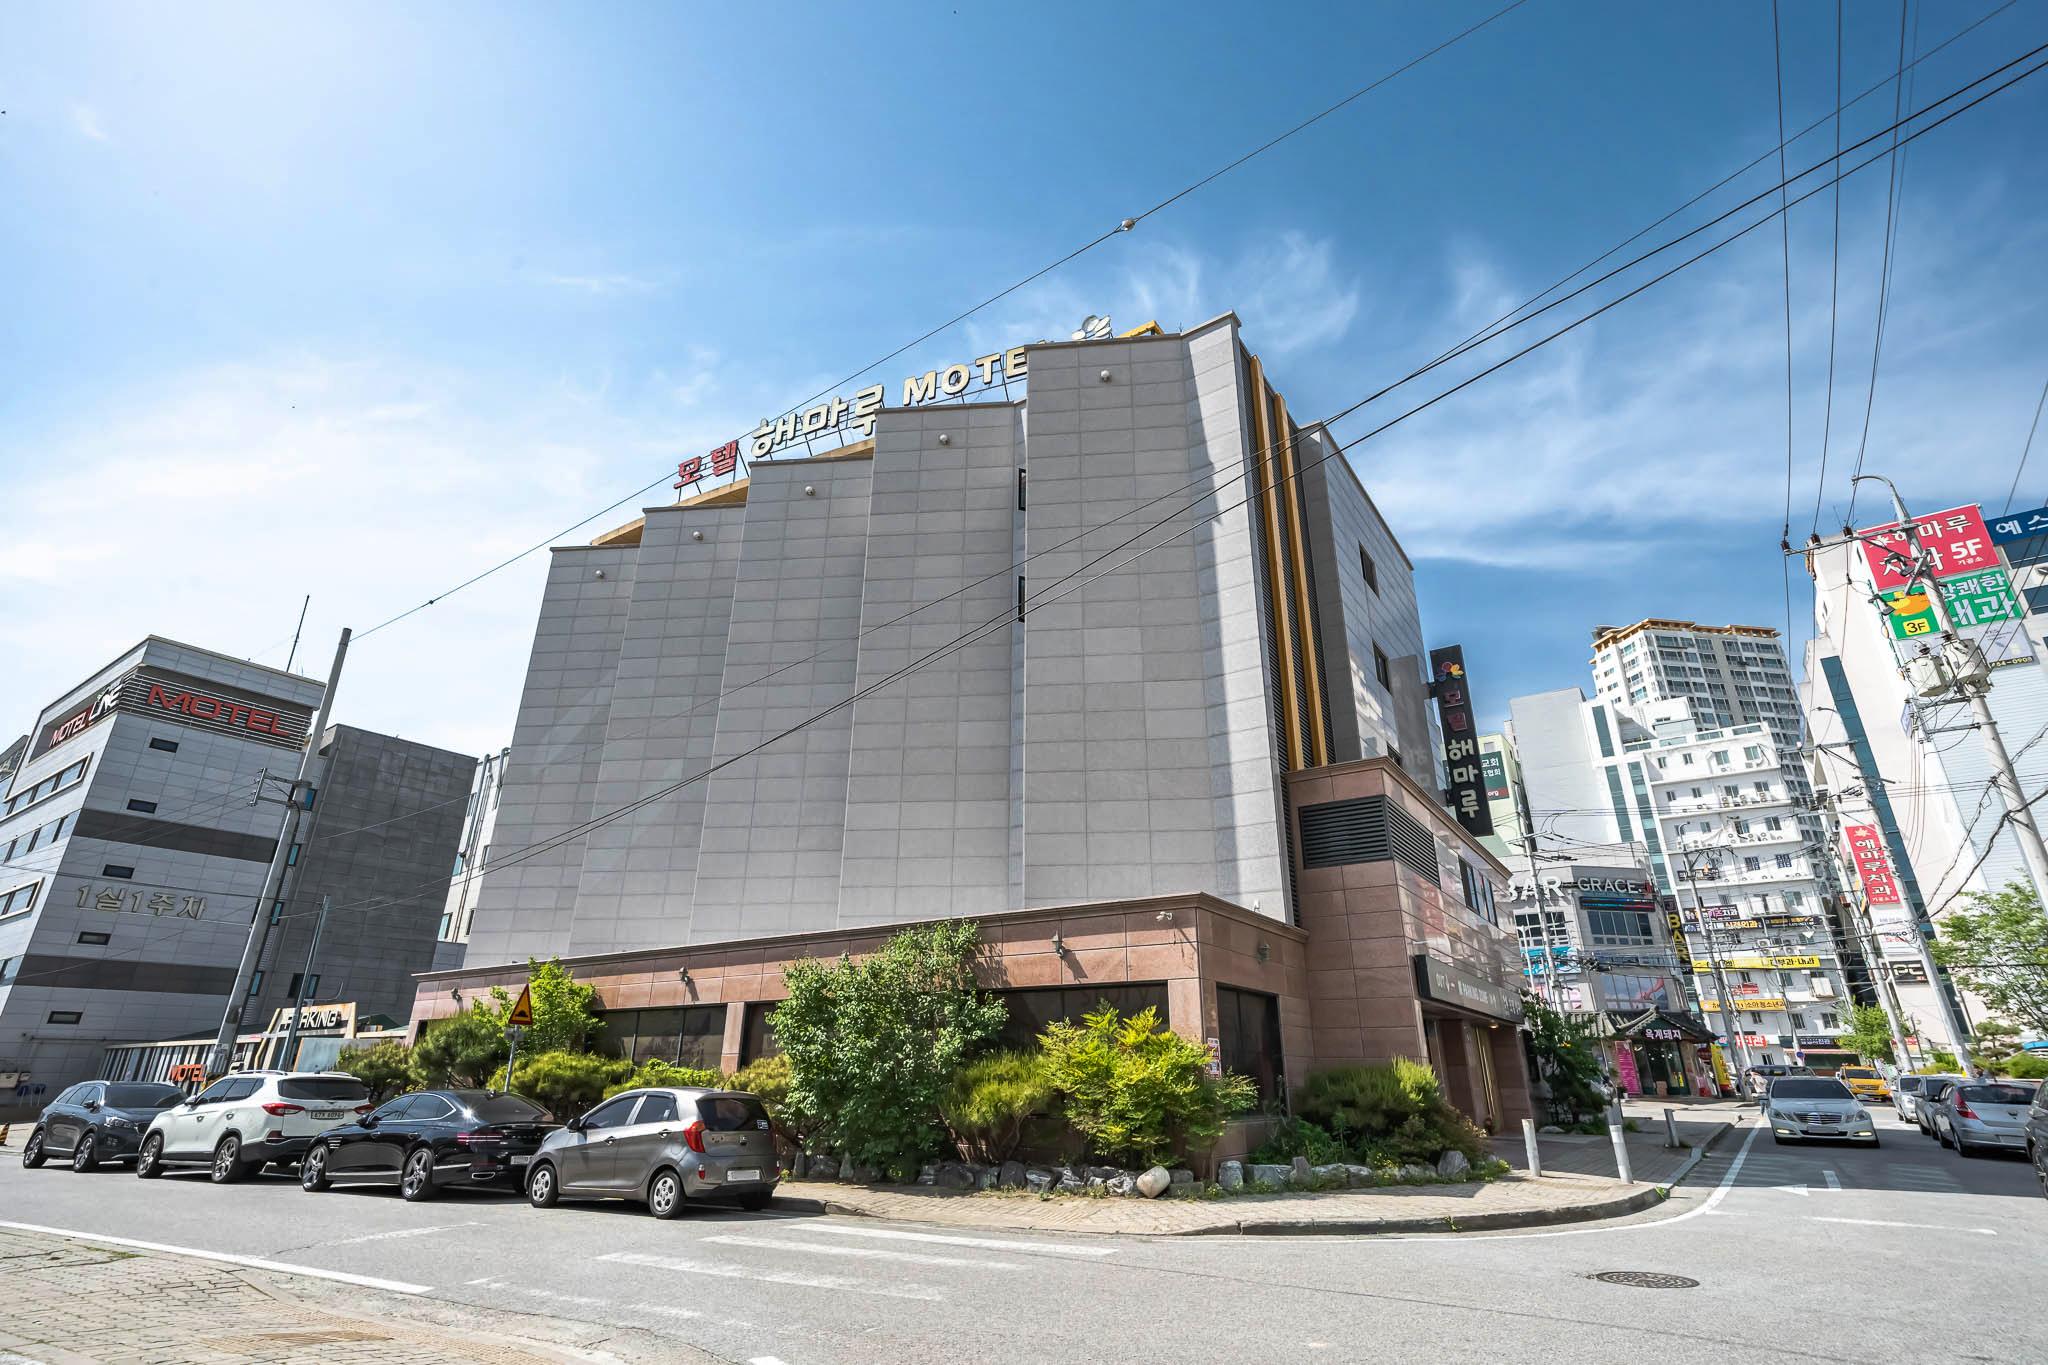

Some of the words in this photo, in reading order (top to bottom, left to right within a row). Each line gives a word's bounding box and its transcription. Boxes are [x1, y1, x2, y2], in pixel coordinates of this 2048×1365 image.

[673, 441, 739, 490] 모텔
[751, 384, 884, 459] 해마루
[903, 347, 1028, 406] MOTE
[1950, 539, 1982, 560] 5F
[1906, 621, 1926, 633] 3F
[148, 683, 289, 738] MOTEL
[49, 711, 87, 748] MOTEL
[1448, 738, 1480, 819] 해마루
[1668, 914, 1690, 960] BAR
[1892, 963, 1924, 976] PC
[284, 1011, 337, 1029] PRKING
[169, 1064, 207, 1082] MOTEL
